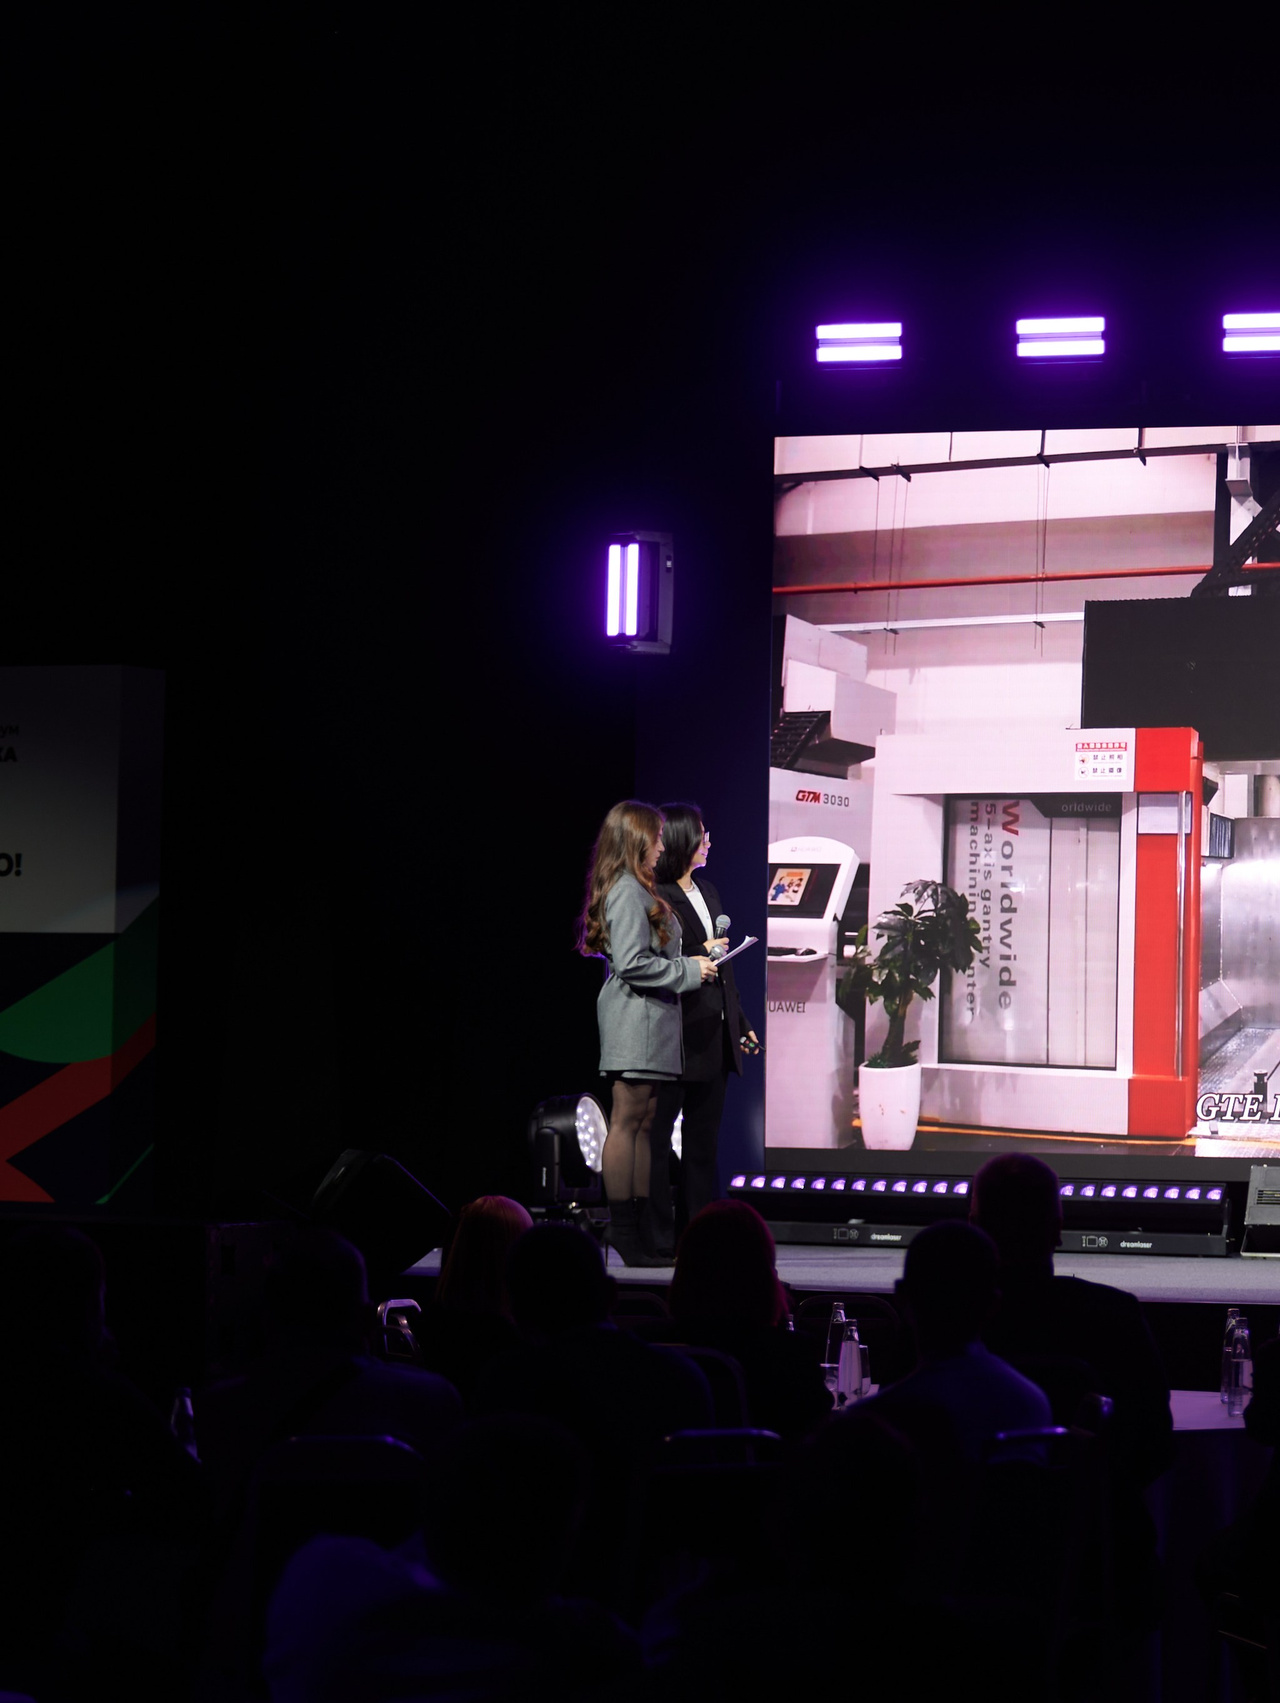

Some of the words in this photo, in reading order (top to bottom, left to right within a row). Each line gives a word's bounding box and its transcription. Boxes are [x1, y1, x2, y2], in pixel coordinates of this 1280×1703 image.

[795, 789, 821, 804] GTM
[823, 793, 850, 808] 3030
[968, 801, 980, 914] machinin
[983, 803, 996, 880] 5-axis
[980, 889, 992, 969] gantry
[999, 800, 1020, 1010] Worldwide
[1196, 1093, 1263, 1121] GTE
